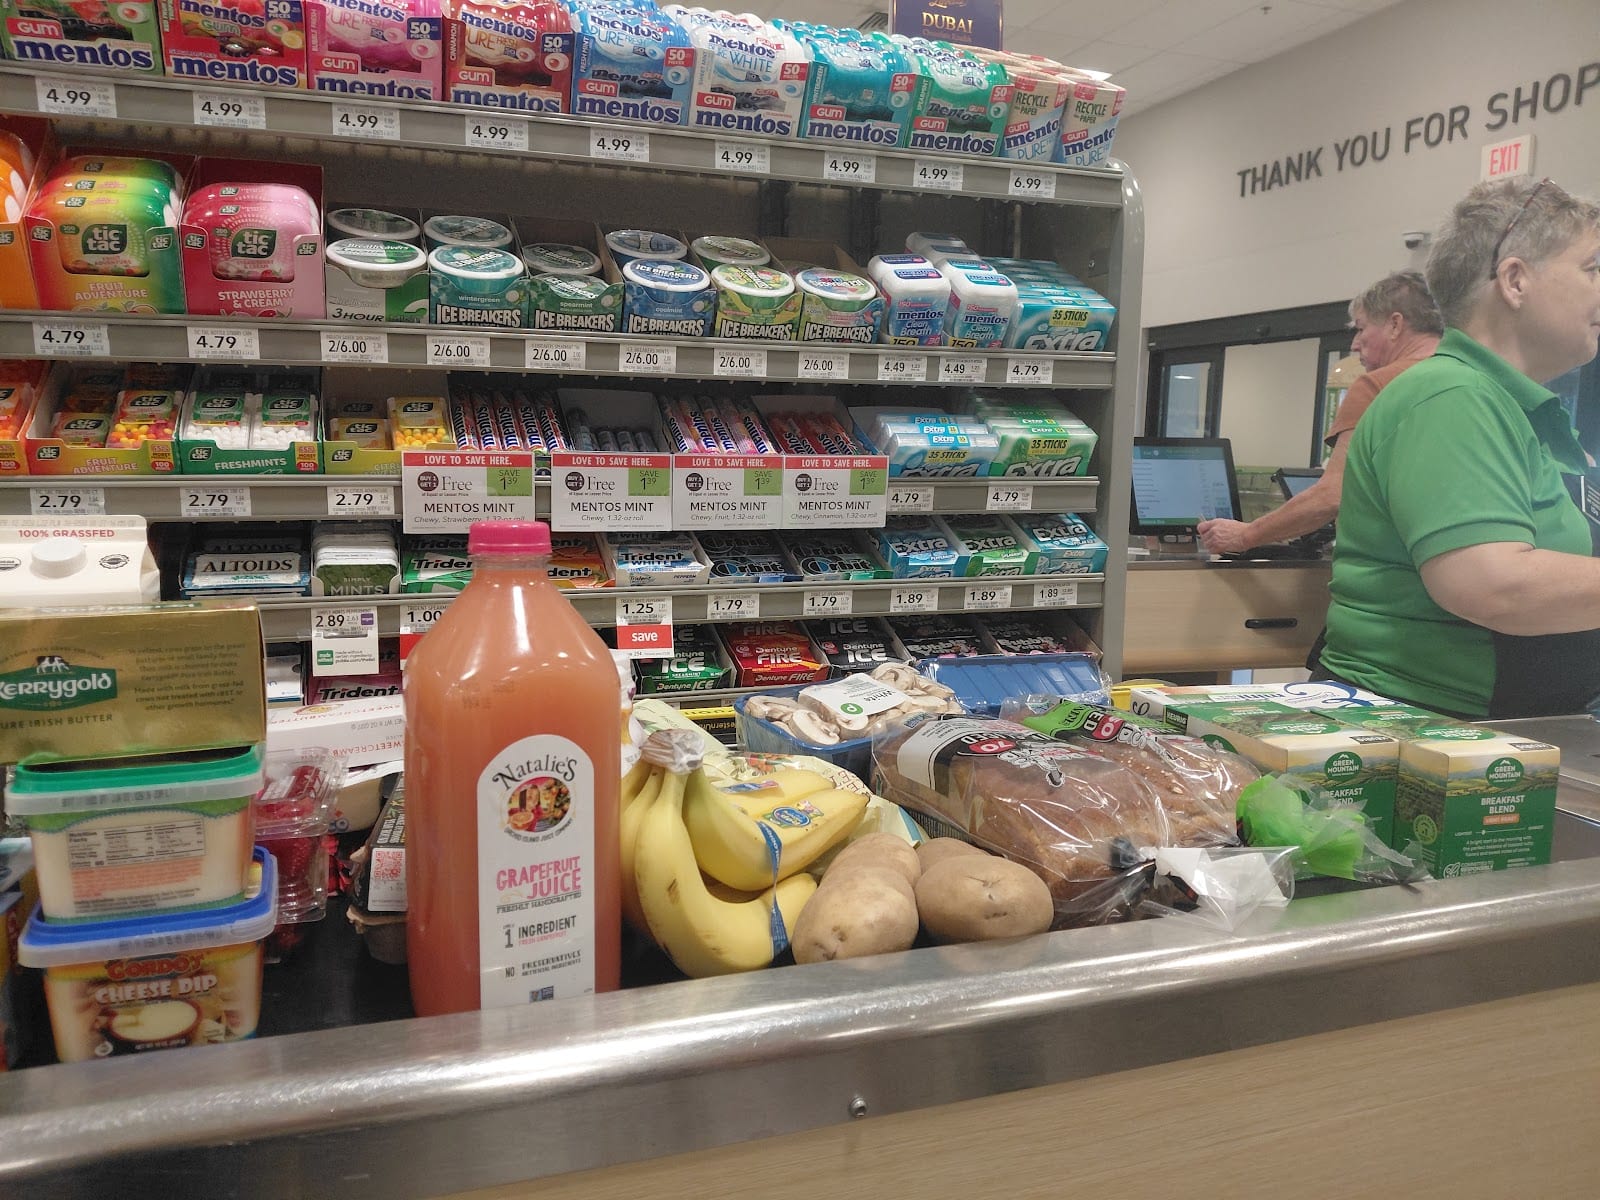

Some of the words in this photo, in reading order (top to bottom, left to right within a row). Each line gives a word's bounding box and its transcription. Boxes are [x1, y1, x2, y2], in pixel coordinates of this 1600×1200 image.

[268, 1, 291, 14] 50
[409, 22, 430, 34] 50
[460, 11, 538, 42] mentos
[922, 12, 973, 33] DUBAI
[450, 23, 458, 61] CINNAMON
[709, 34, 776, 59] mentos
[14, 40, 153, 68] mentos
[729, 51, 773, 73] WHITE
[173, 56, 297, 86] mentos
[46, 89, 91, 105] 4.99
[1015, 91, 1049, 108] RECYCLE
[201, 101, 243, 117] 4.99
[577, 95, 681, 125] mentos
[1020, 106, 1038, 116] PAPER
[1075, 101, 1107, 116] RECYCLE
[339, 114, 378, 129] 4.99
[696, 109, 791, 136] mentos
[472, 125, 508, 139] 4.99
[808, 121, 898, 145] mentos
[1237, 147, 1325, 198] THANK
[1333, 127, 1391, 172] YOU
[1403, 104, 1470, 153] FOR
[1485, 62, 1600, 131] SHOP
[597, 138, 631, 151] 4.99
[911, 132, 996, 155] mentos
[721, 151, 752, 163] 4.99
[1489, 143, 1521, 177] EXIT
[829, 160, 859, 173] 4.99
[919, 169, 948, 180] 4.99
[1014, 177, 1041, 189] 6.99
[95, 226, 120, 240] tic
[87, 238, 120, 251] tac
[89, 283, 124, 292] FRUIT
[75, 290, 148, 301] ADVENTURE
[218, 289, 294, 300] STRAWBERRY
[244, 299, 283, 307] CREAM
[332, 308, 343, 319] 3
[343, 312, 385, 322] HOUR
[436, 304, 458, 324] ICE
[459, 308, 521, 328] BREAKERS
[534, 310, 556, 328] ICE
[556, 311, 615, 332] BREAKERS
[897, 310, 944, 319] mentos
[964, 314, 1009, 324] mentos
[1052, 310, 1062, 320] 35
[1064, 310, 1088, 321] STICKS
[629, 314, 647, 333] ICE
[648, 316, 704, 336] BREAKERS
[721, 319, 738, 336] ICE
[738, 321, 793, 340] BREAKERS
[42, 331, 85, 344] 4.79
[804, 322, 822, 340] ICE
[823, 323, 874, 342] BREAKERS
[196, 336, 237, 349] 4.79
[328, 340, 367, 353] 2/6.00
[434, 344, 470, 357] 2/6.00
[532, 348, 567, 361] 2/6.00
[626, 352, 658, 364] 2/6.00
[720, 357, 750, 368] 2/6.00
[804, 359, 833, 371] 2/6.00
[884, 362, 905, 371] 4.49
[945, 363, 965, 373] 4.49
[1012, 365, 1039, 375] 4.79
[1031, 440, 1041, 449] 35
[1042, 439, 1068, 449] STICKS
[424, 455, 446, 465] LOVE
[450, 456, 461, 465] TO
[466, 456, 486, 465] SAVE
[490, 456, 512, 465] HERE.
[941, 451, 967, 459] STICKS
[73, 463, 138, 474] ADVENTURE
[86, 458, 118, 466] FRUIT
[214, 458, 287, 470] FRESHMINTS
[801, 459, 821, 467] LOVE
[823, 459, 831, 467] TO
[833, 459, 851, 467] SAVE
[853, 459, 872, 468] HERE.
[442, 476, 472, 491] Free
[588, 476, 615, 491] Free
[814, 477, 839, 491] Free
[39, 495, 81, 508] 2.79
[189, 494, 228, 506] 2.79
[336, 494, 373, 505] 2.79
[891, 493, 919, 503] 4.79
[992, 492, 1018, 502] 4.79
[424, 503, 480, 513] MENTOS
[484, 503, 516, 513] MINT
[570, 502, 621, 512] MENTOS
[625, 502, 654, 512] MINT
[798, 501, 844, 511] MENTOS
[846, 501, 871, 510] MINT
[18, 530, 49, 538] 100%
[53, 529, 115, 538] GRASSFED
[620, 552, 684, 561] Trident
[202, 559, 293, 573] ALTOIDS
[711, 557, 785, 577] Orbit
[801, 557, 874, 576] Orbit
[330, 585, 384, 596] MINTS
[970, 592, 996, 601] 1.89
[1040, 589, 1058, 598] 1.89
[808, 596, 837, 607] 1.79
[897, 593, 923, 604] 1.89
[622, 603, 654, 614] 1.25
[713, 600, 743, 611] 1.79
[315, 615, 345, 627] 2.89
[631, 631, 658, 643] save
[757, 652, 803, 665] FIRE
[848, 650, 887, 662] ICE
[661, 657, 705, 673] ICE
[319, 685, 399, 699] Trident
[656, 683, 691, 691] Dentyne
[693, 680, 715, 690] ICE
[29, 719, 63, 727] IRISH
[68, 714, 113, 724] BUTTER
[1328, 765, 1359, 773] MOUNTAIN
[1333, 759, 1354, 767] GREEN
[1481, 795, 1525, 805] BREAKFAST
[1489, 805, 1515, 814] BLEND
[496, 856, 580, 891] GRAPEFRUIT
[527, 868, 581, 899] JUICE
[504, 929, 514, 948] 1
[518, 915, 577, 938] INGREDIENT
[505, 967, 515, 978] NO
[522, 950, 581, 969] PRESERVATIVES
[95, 980, 171, 1003] CHEESE
[178, 975, 218, 994] DIP
